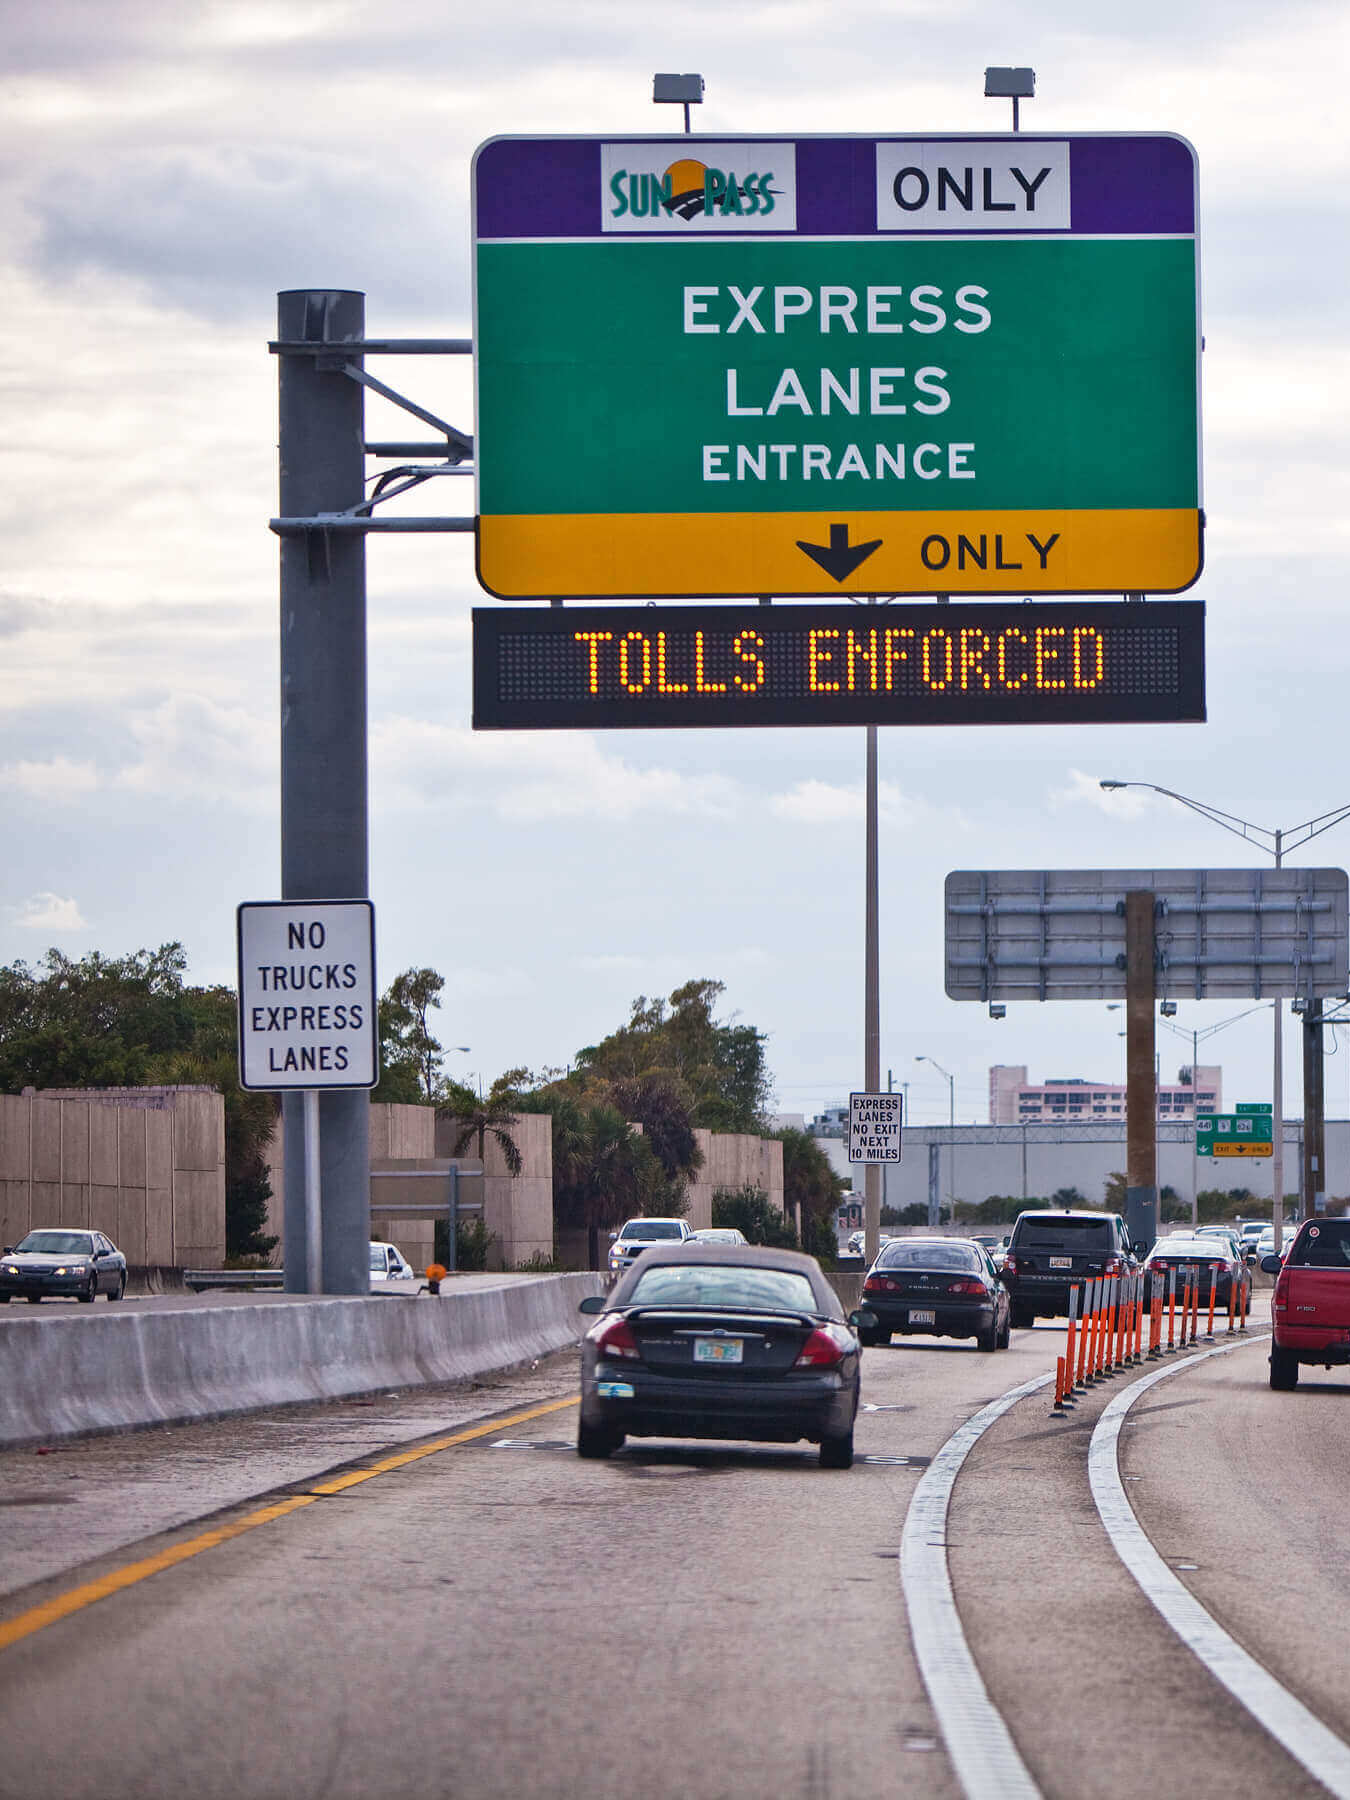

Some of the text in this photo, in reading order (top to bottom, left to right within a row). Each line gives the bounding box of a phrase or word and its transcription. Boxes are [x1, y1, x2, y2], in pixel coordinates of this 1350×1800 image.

[892, 166, 1052, 212] ONLY
[682, 284, 993, 335] EXPRESS
[726, 366, 952, 416] LANES
[702, 442, 976, 481] ENTRANCE
[919, 533, 1061, 571] ONLY
[575, 627, 1104, 694] TOLLS ENFORCED
[288, 921, 326, 950] NO
[257, 964, 357, 991] TRUCKS
[252, 1005, 363, 1032] EXPRESS
[269, 1046, 349, 1072] LANES
[853, 1099, 898, 1110] EXPRESS
[858, 1112, 893, 1122] LANES
[853, 1124, 898, 1135] NO EXIT
[860, 1136, 890, 1147] NEXT
[852, 1148, 898, 1159] 10 MILES
